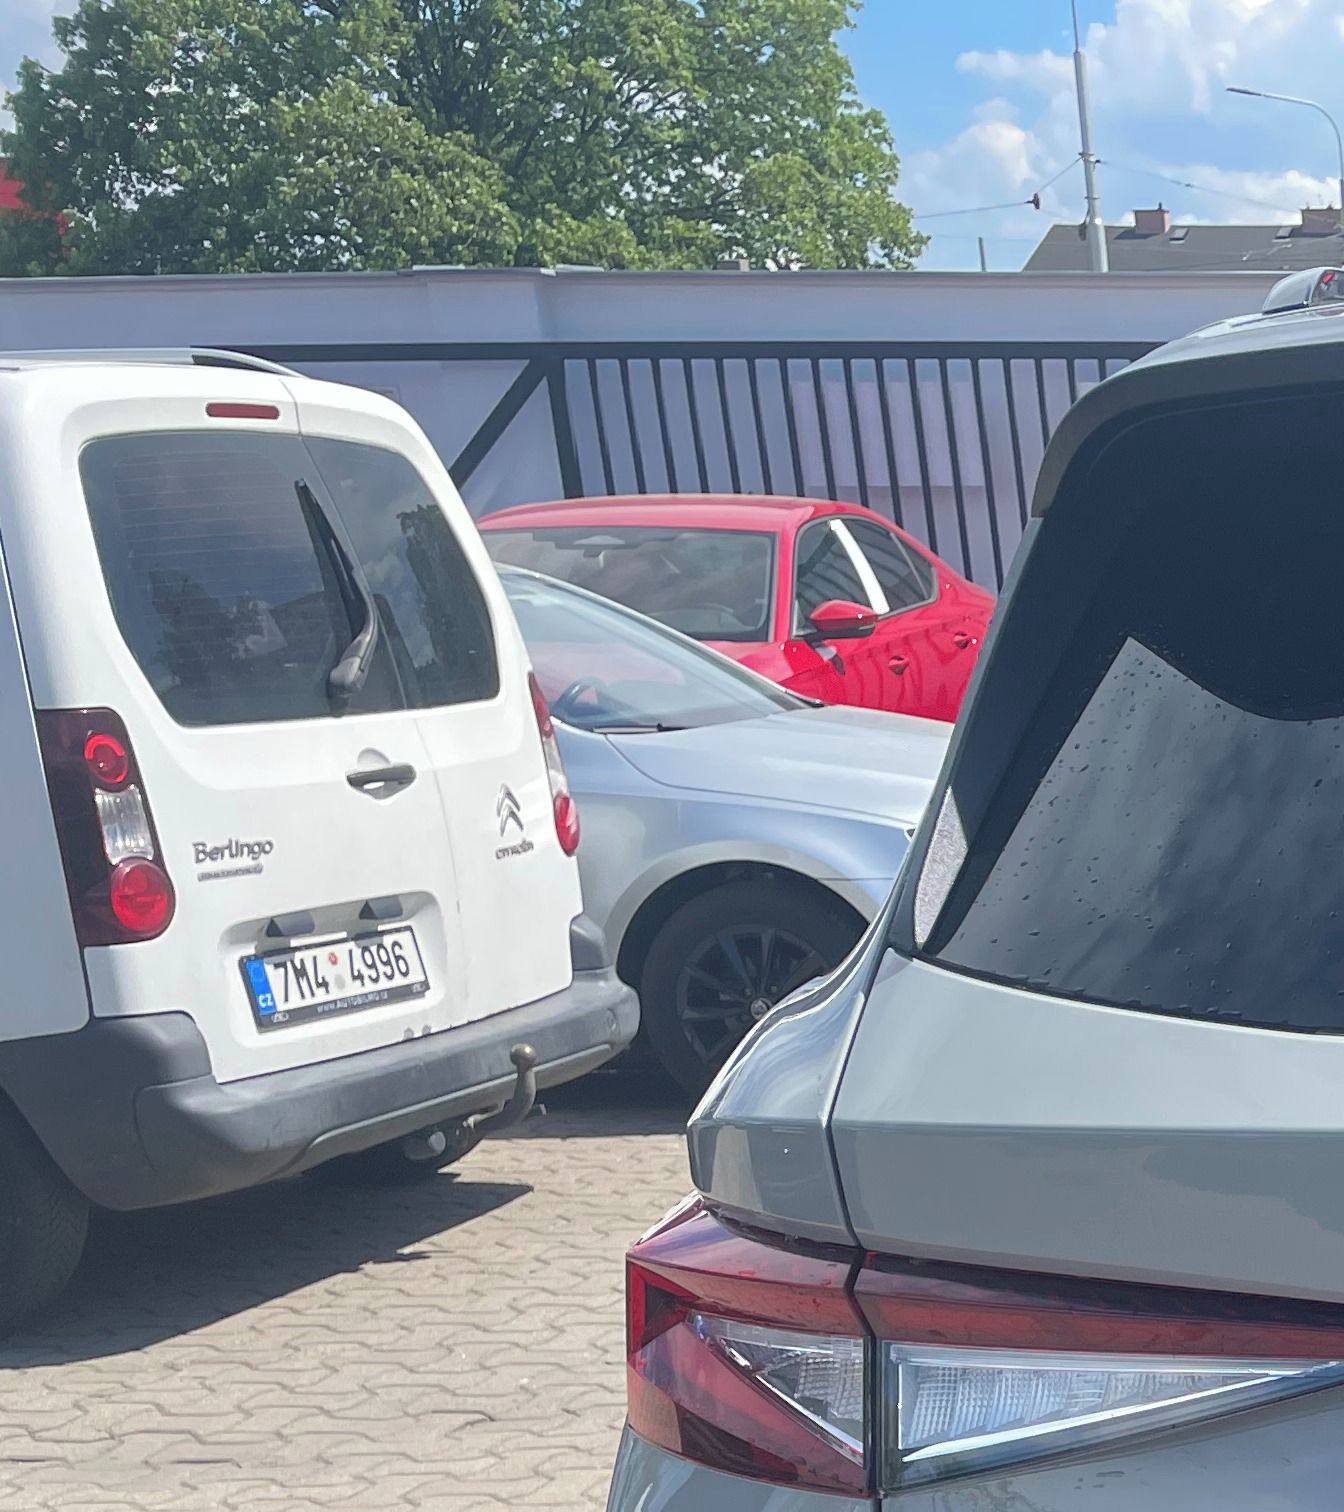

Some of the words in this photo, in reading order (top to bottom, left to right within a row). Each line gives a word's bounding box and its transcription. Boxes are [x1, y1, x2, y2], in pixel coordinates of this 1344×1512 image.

[192, 838, 274, 864] Berlingo
[273, 954, 330, 1002] 7M4
[349, 940, 410, 987] 4996
[258, 993, 273, 1008] CZ
